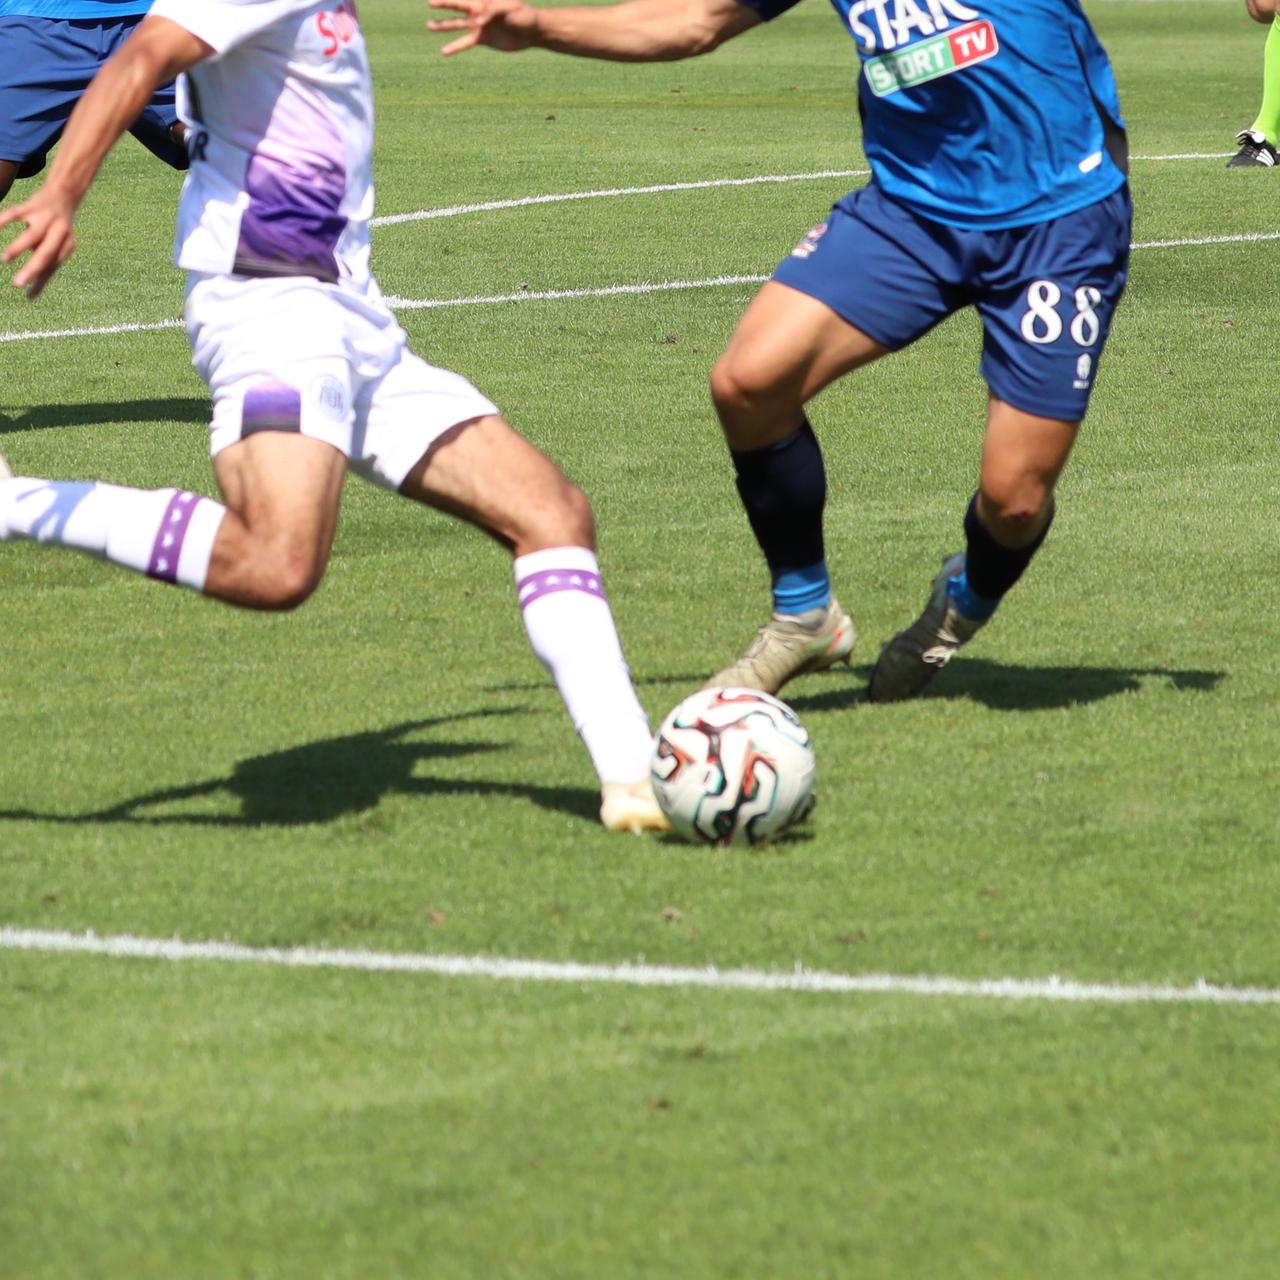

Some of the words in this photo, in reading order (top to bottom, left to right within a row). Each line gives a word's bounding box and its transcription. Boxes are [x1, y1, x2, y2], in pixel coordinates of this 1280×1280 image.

[870, 45, 950, 93] SPORT
[956, 28, 988, 58] TV
[1020, 279, 1102, 347] 88
